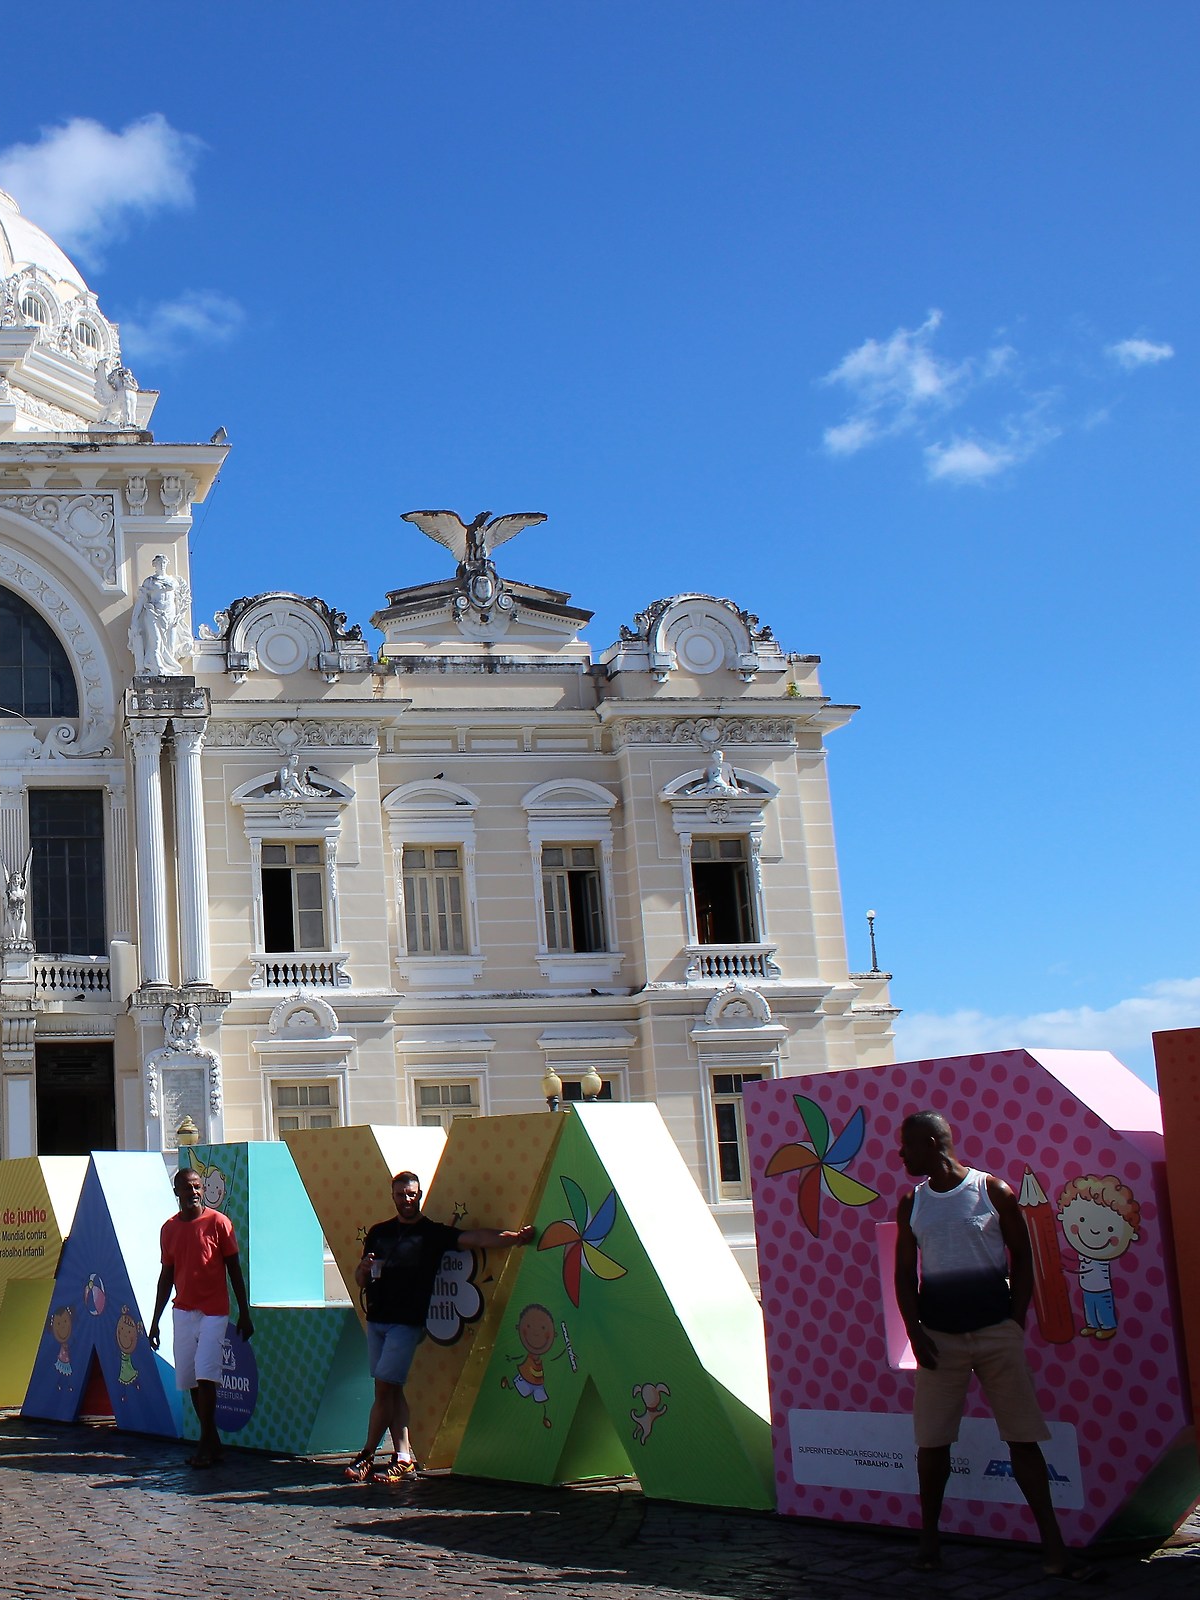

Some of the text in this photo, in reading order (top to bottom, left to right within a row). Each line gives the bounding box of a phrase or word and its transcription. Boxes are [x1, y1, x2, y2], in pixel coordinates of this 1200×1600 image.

[3, 1208, 15, 1225] de
[17, 1206, 47, 1227] junho
[2, 1230, 26, 1241] Mundial
[26, 1230, 47, 1240] contra
[23, 1246, 45, 1257] Infantil
[451, 1258, 463, 1271] de
[858, 1450, 892, 1459] REGIONAL
[892, 1452, 903, 1460] DO
[854, 1459, 889, 1468] TRABALHO
[894, 1461, 904, 1469] BA
